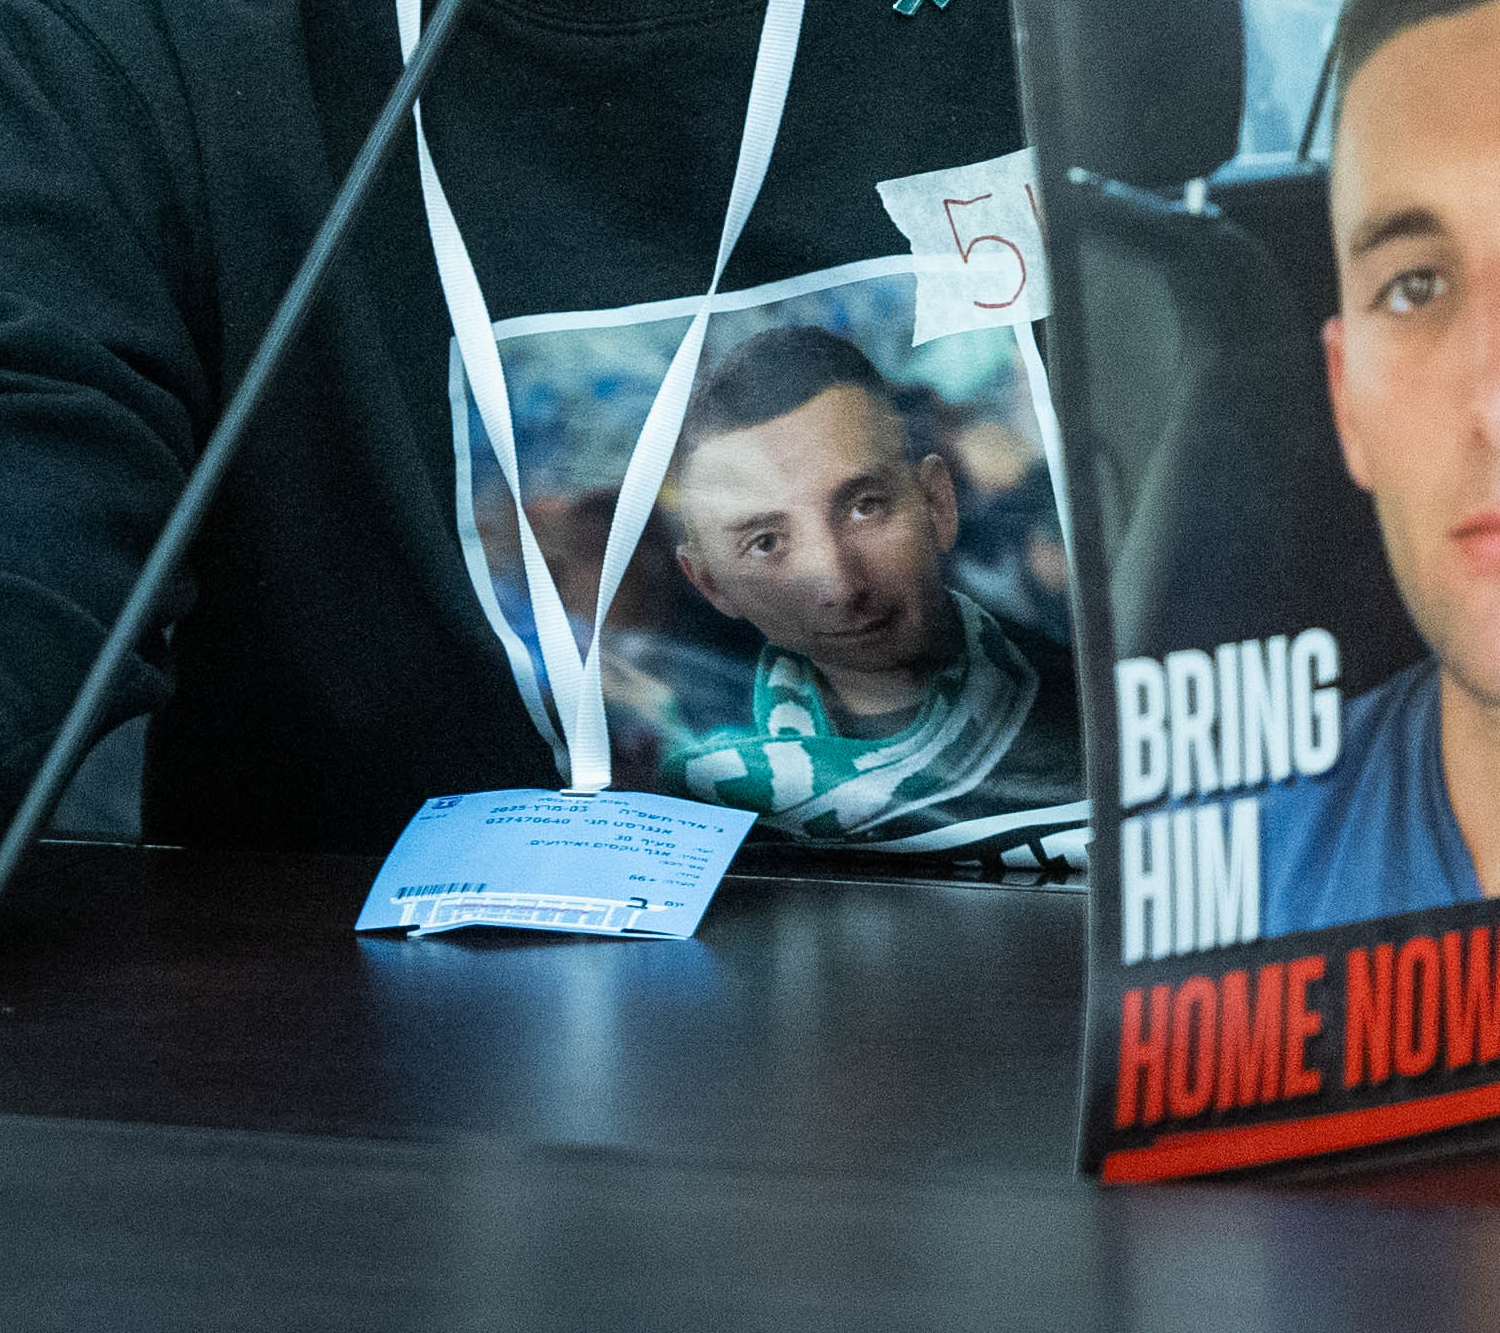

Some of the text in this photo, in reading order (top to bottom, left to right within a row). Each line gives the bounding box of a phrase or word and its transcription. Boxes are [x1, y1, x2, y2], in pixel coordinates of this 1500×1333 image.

[1115, 627, 1341, 810] BRING
[1120, 796, 1261, 967] HIM
[1114, 953, 1326, 1131] HOME
